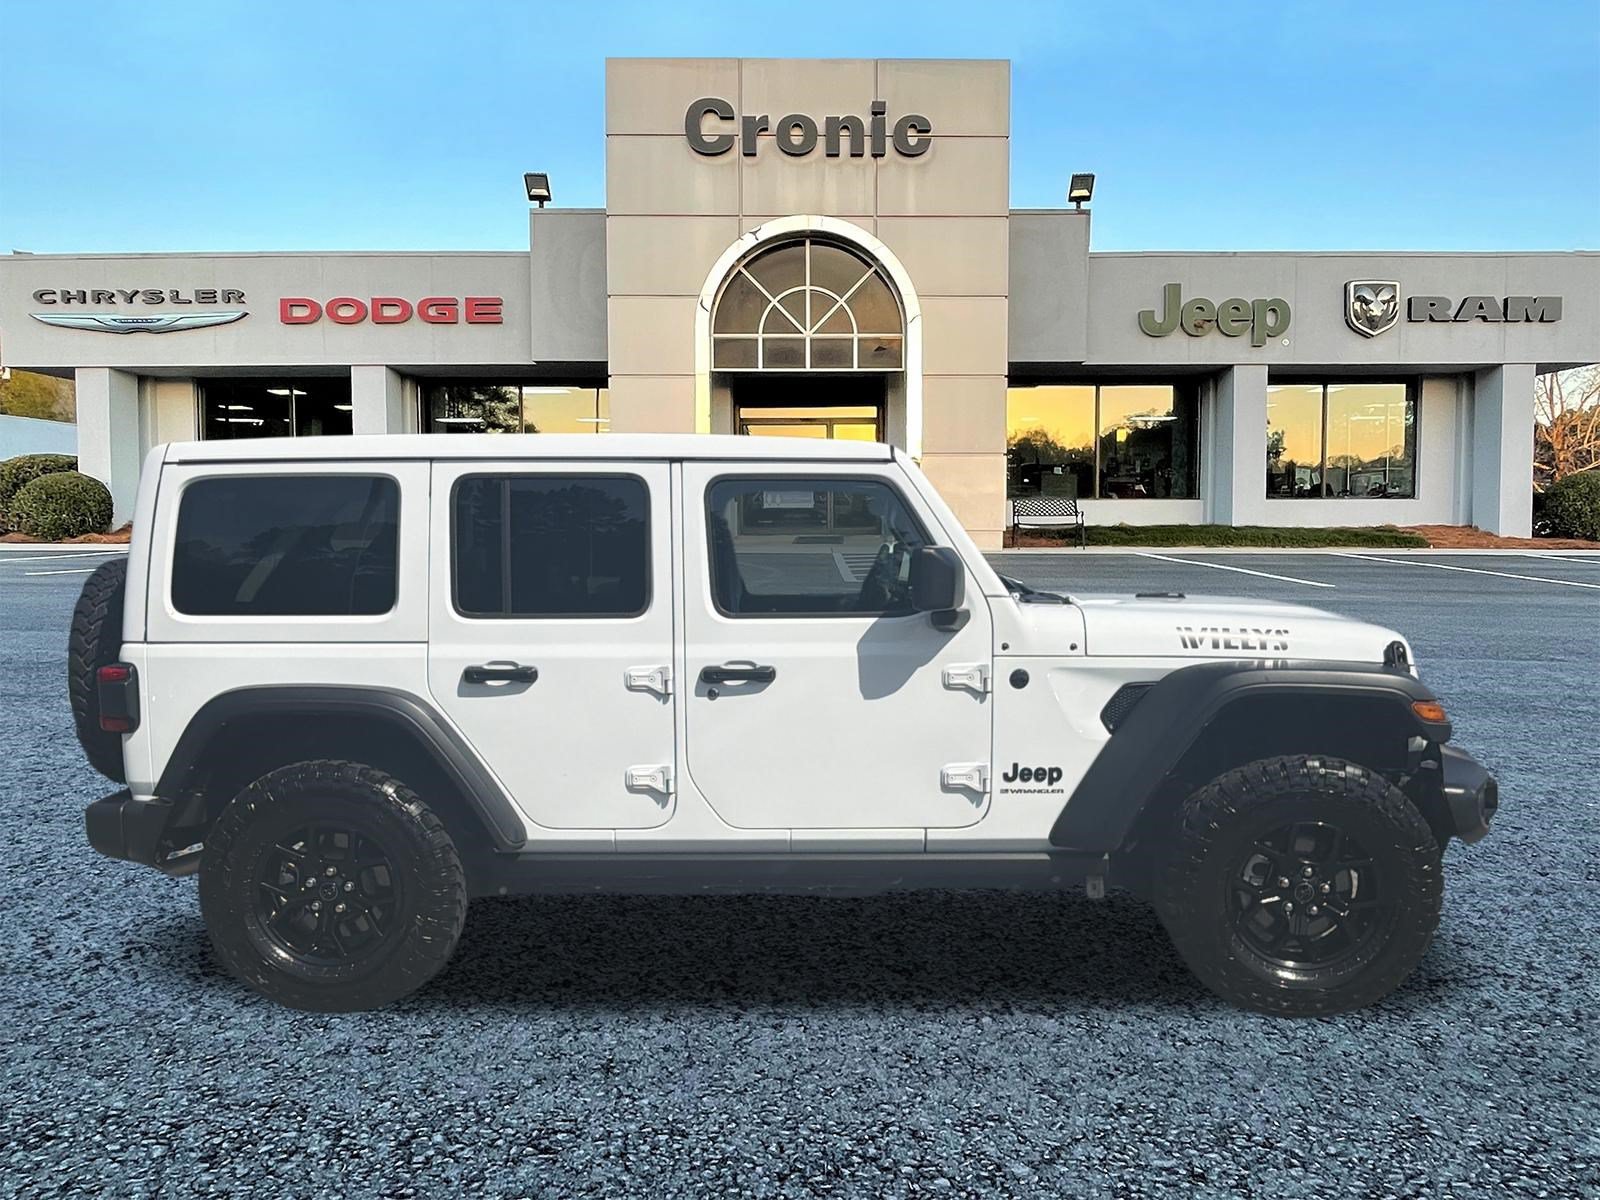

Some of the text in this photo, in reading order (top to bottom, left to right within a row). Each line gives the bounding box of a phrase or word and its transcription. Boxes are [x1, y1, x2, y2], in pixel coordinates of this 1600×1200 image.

[685, 97, 932, 157] Cronic
[32, 289, 248, 304] CHRYSLER
[1407, 296, 1563, 322] RAM
[279, 297, 503, 325] DODGE
[1138, 283, 1291, 347] Jeep
[1176, 626, 1289, 651] WILLYS
[1002, 762, 1063, 786] Jeep
